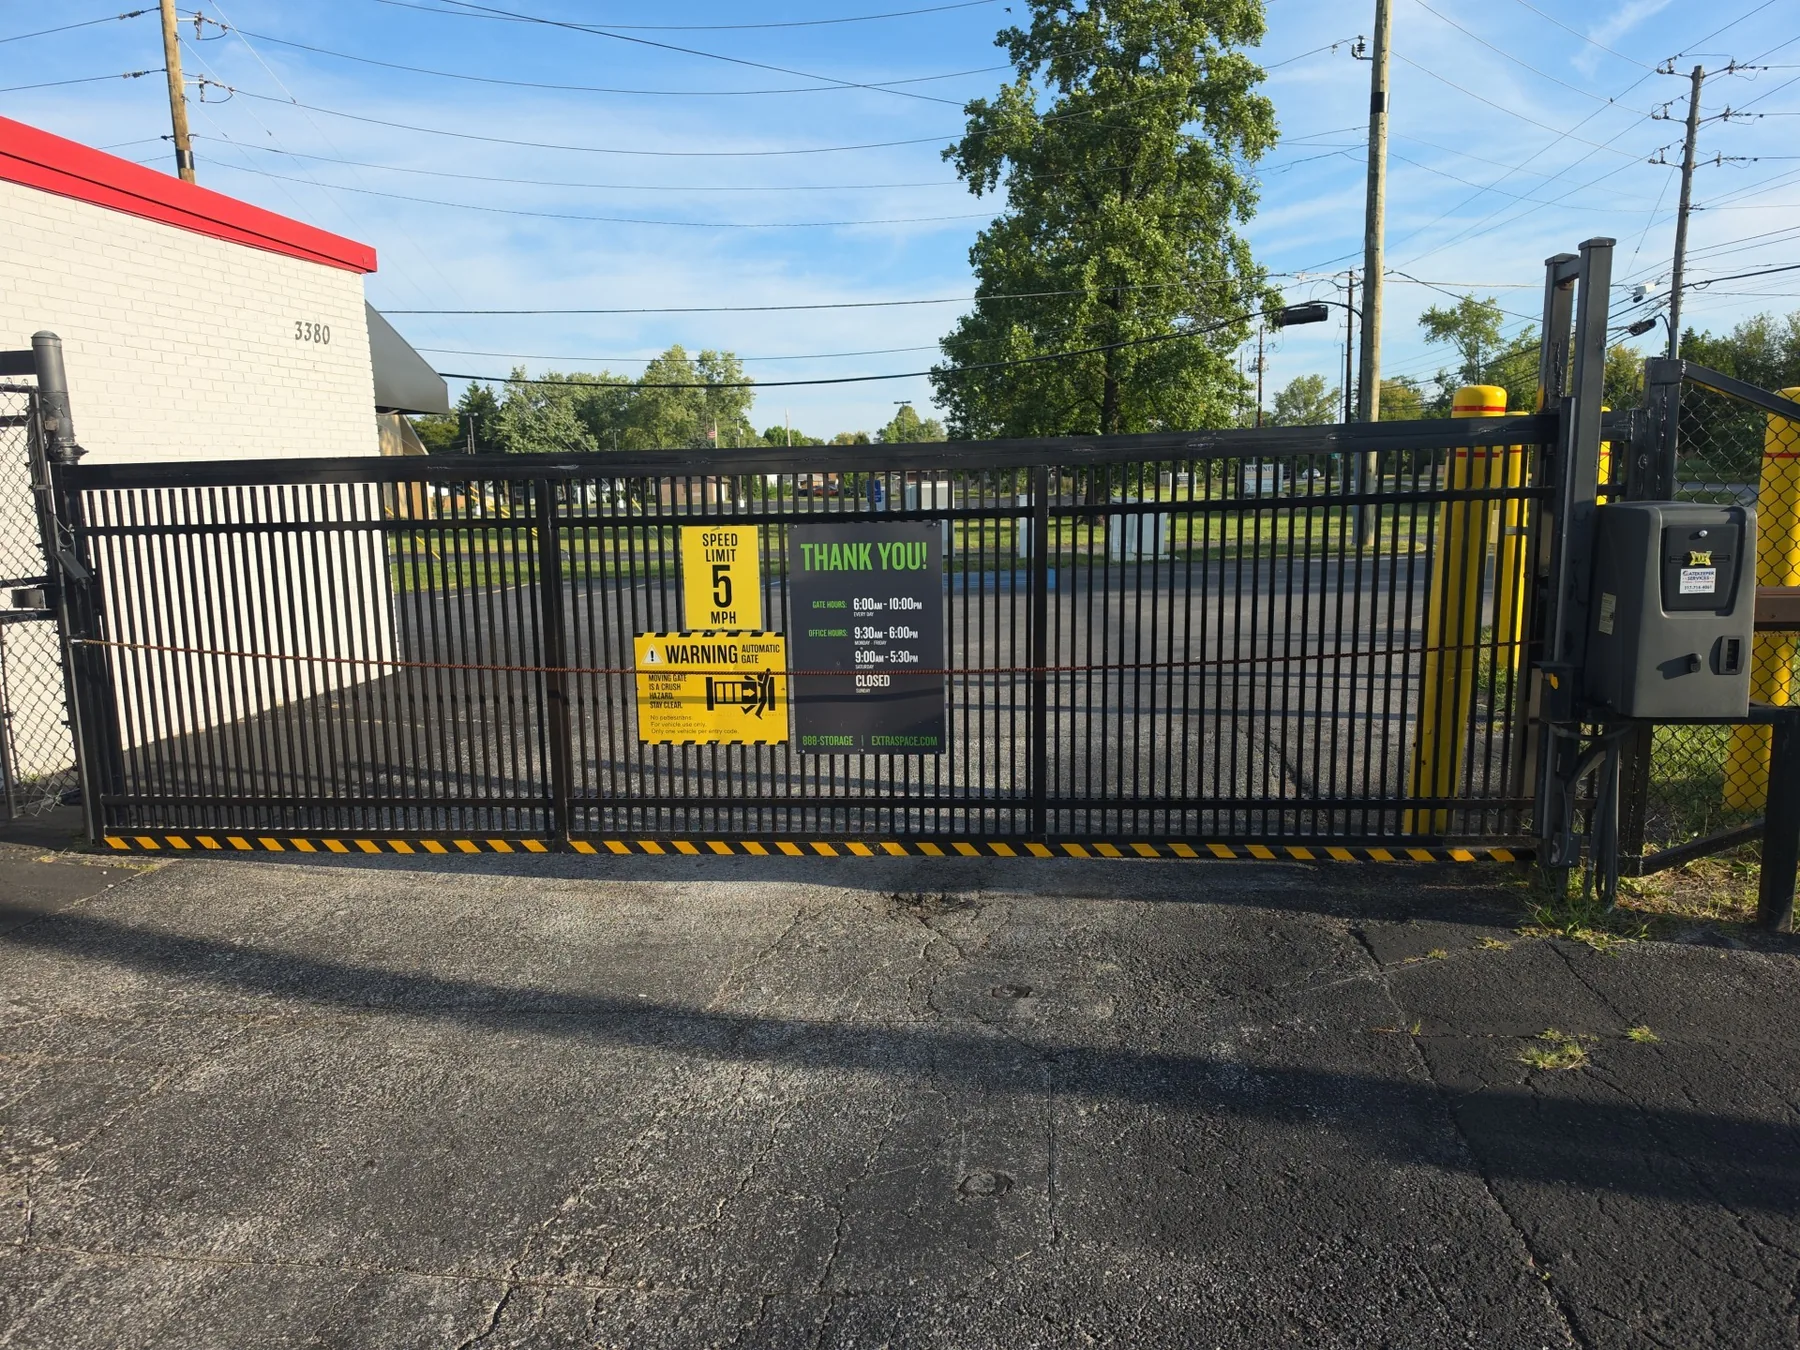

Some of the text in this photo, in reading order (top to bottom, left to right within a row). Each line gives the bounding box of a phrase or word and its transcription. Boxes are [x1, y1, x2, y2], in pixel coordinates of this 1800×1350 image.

[295, 320, 331, 345] 3380
[702, 533, 738, 547] SPEED
[705, 549, 737, 562] LIMIT
[800, 541, 928, 571] THANK YOU!
[712, 564, 732, 608] 5
[812, 601, 826, 609] GATE
[826, 601, 848, 609] HOURS:
[853, 598, 883, 610] 6:00AM
[889, 597, 923, 610] 10:00PM
[711, 611, 737, 624] MPH
[827, 629, 848, 637] HOURS:
[854, 626, 883, 639] 9:30AM
[889, 626, 919, 639] 6:00PM
[665, 644, 780, 664] WARNING AUTOMATIC
[741, 654, 759, 664] GATE
[854, 650, 884, 663] 9:00AM
[890, 650, 919, 663] 5:30PM
[649, 674, 687, 682] MOVING GATE
[855, 674, 890, 687] CLOSED
[649, 692, 674, 700] HAZARD.
[649, 701, 683, 709] STAY CLEAR.
[802, 735, 938, 746] 888-STORAGE EXTRASPACE.COM
